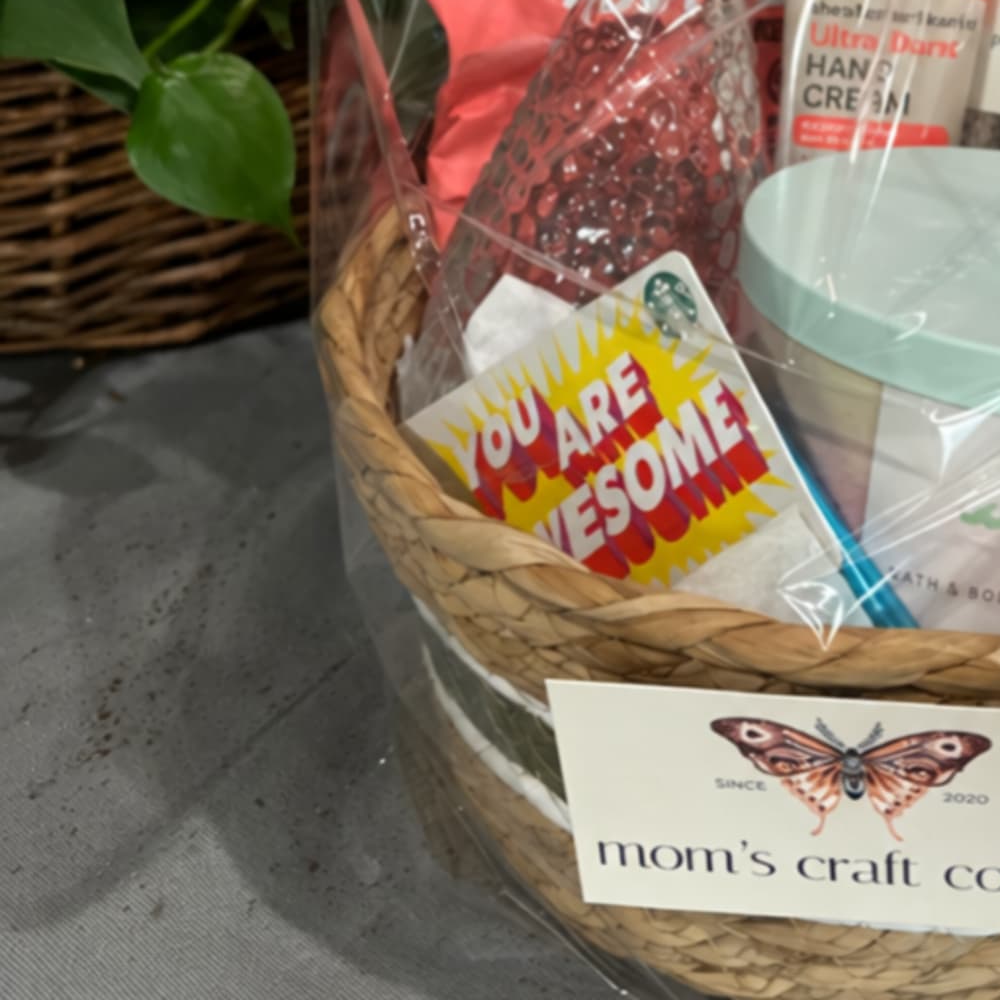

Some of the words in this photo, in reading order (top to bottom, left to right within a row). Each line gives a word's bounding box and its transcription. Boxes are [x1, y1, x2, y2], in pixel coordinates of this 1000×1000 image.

[810, 22, 879, 50] Ultra
[456, 385, 542, 490] YOU
[553, 350, 649, 472] ARE
[713, 776, 768, 792] SINCE
[942, 791, 991, 806] 2020
[596, 838, 777, 879] mom's
[795, 850, 922, 888] craft
